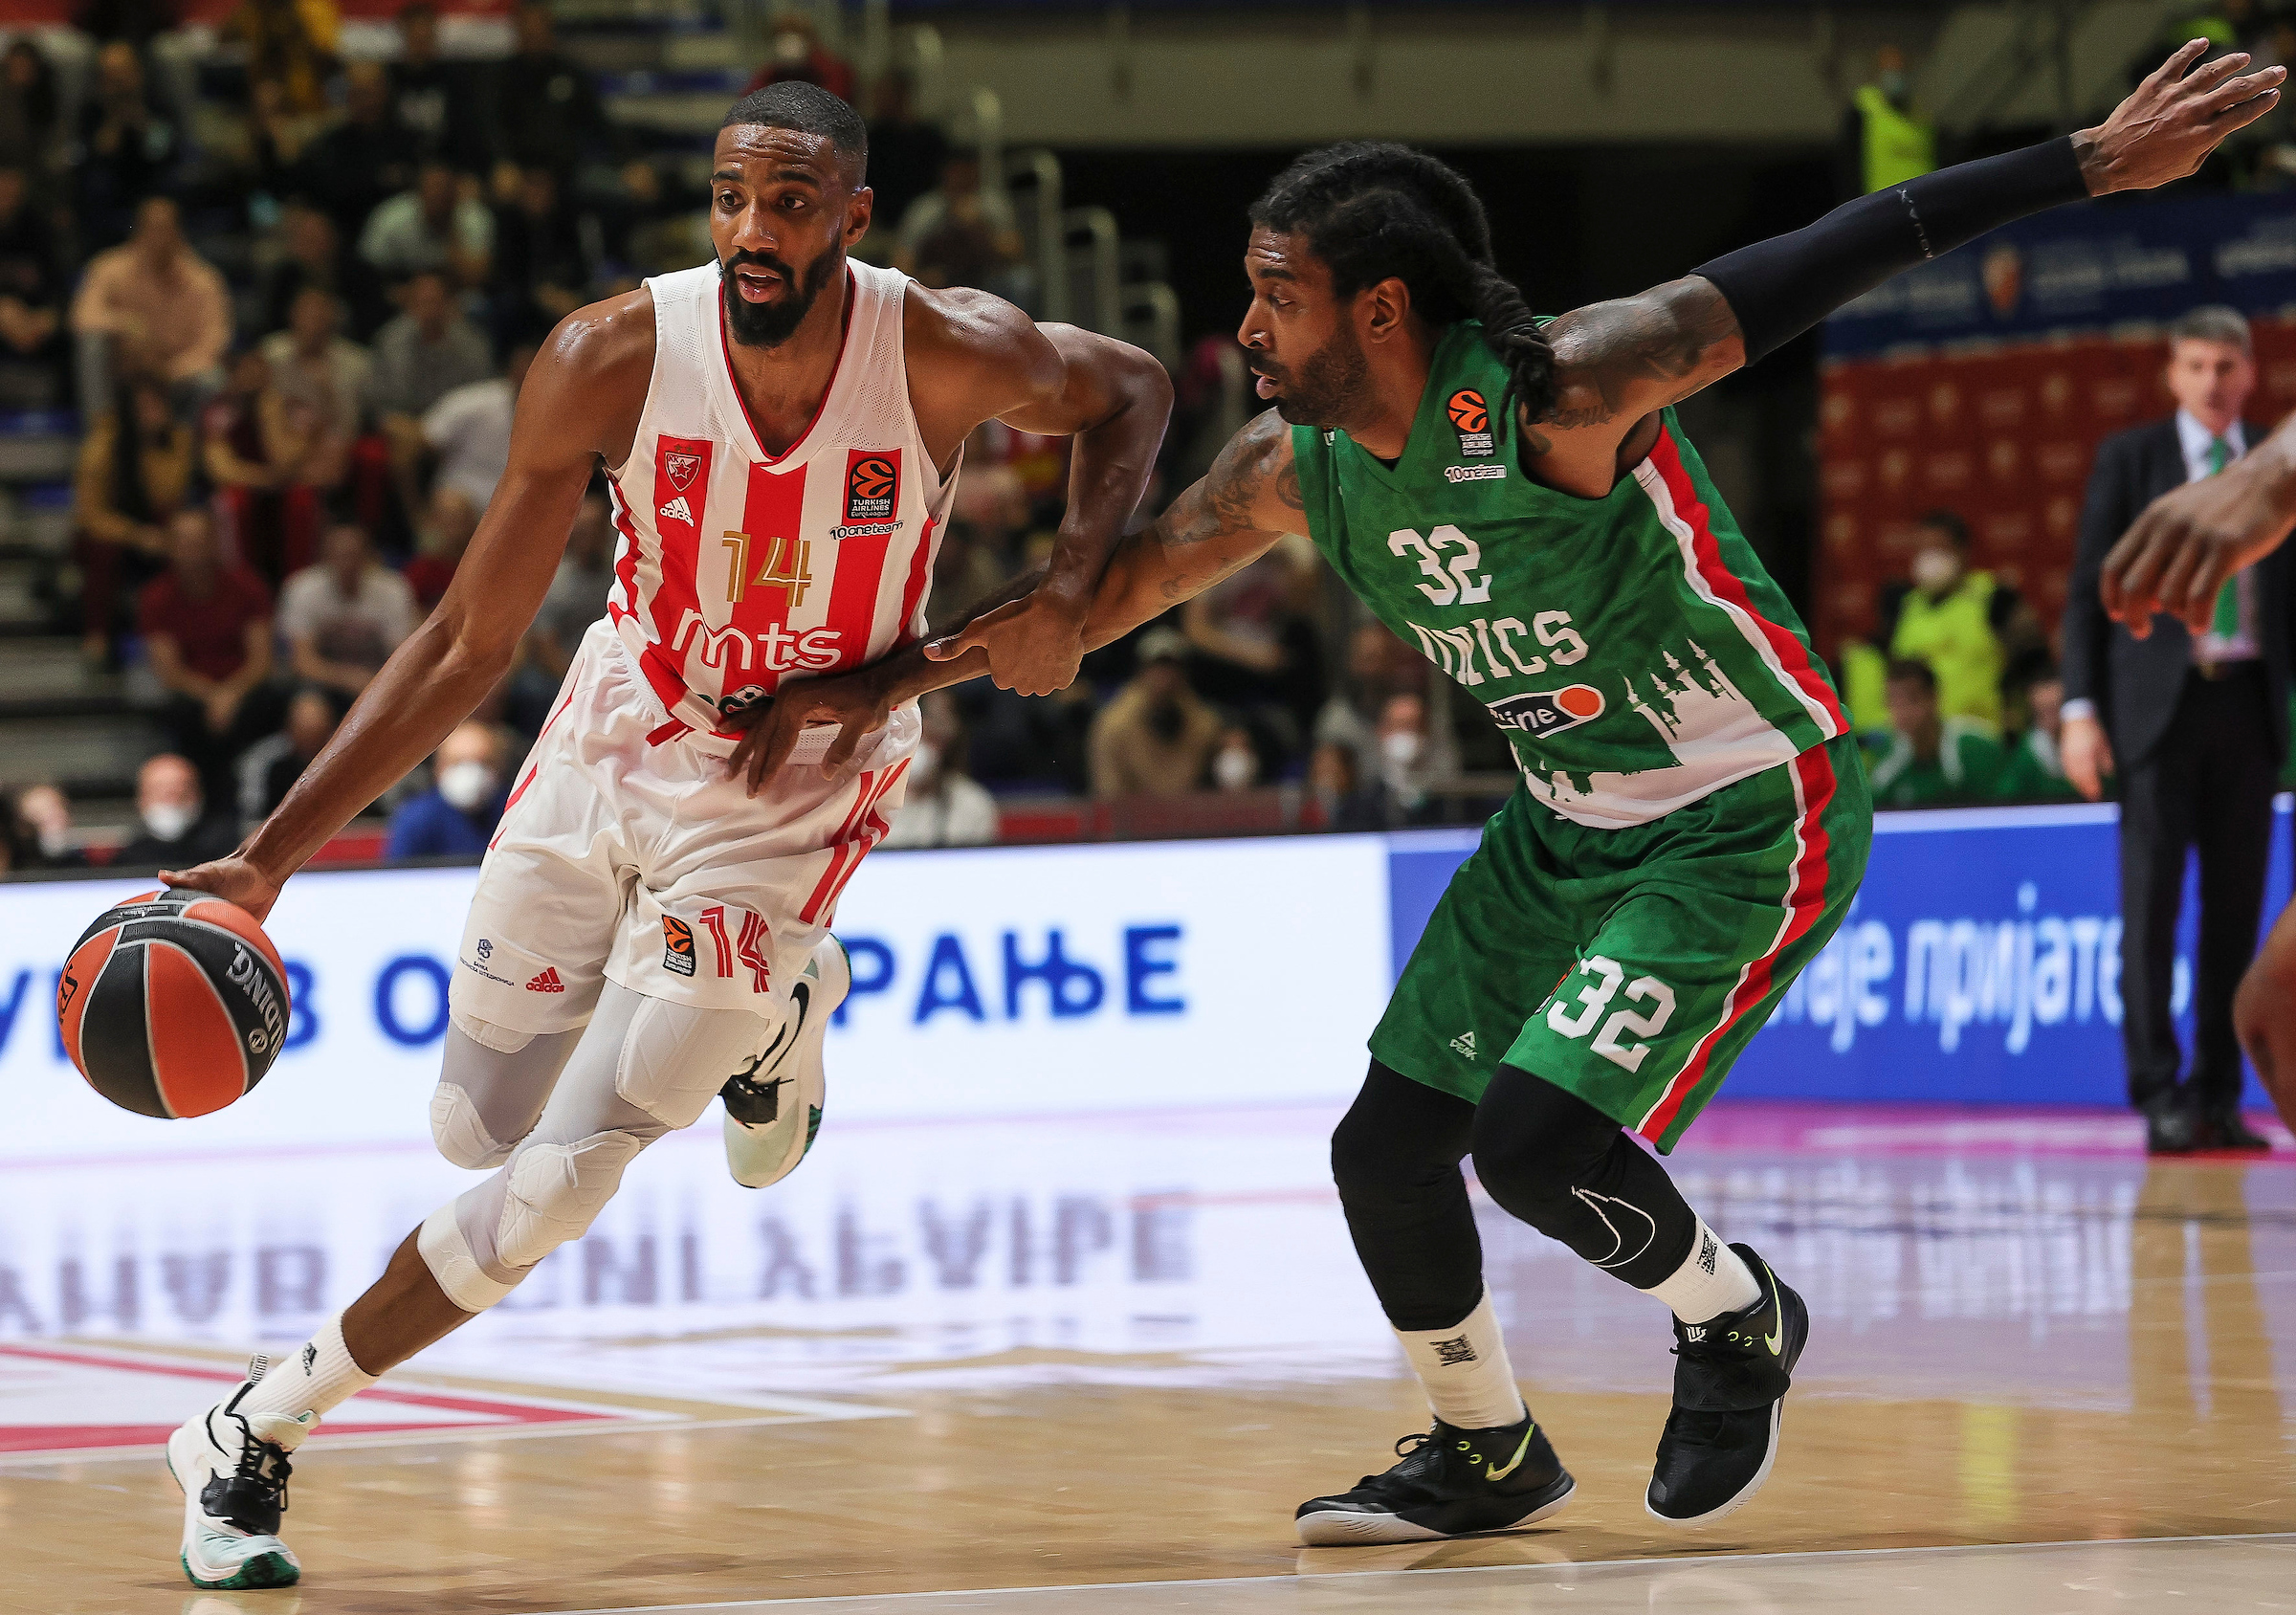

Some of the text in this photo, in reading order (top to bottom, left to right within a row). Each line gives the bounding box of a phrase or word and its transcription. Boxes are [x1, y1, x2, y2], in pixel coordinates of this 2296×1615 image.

[721, 530, 812, 608] 14
[1387, 523, 1493, 606] 32
[671, 608, 842, 671] mts
[525, 982, 564, 993] adidas
[699, 905, 771, 993] 14
[1546, 955, 1677, 1073] 32
